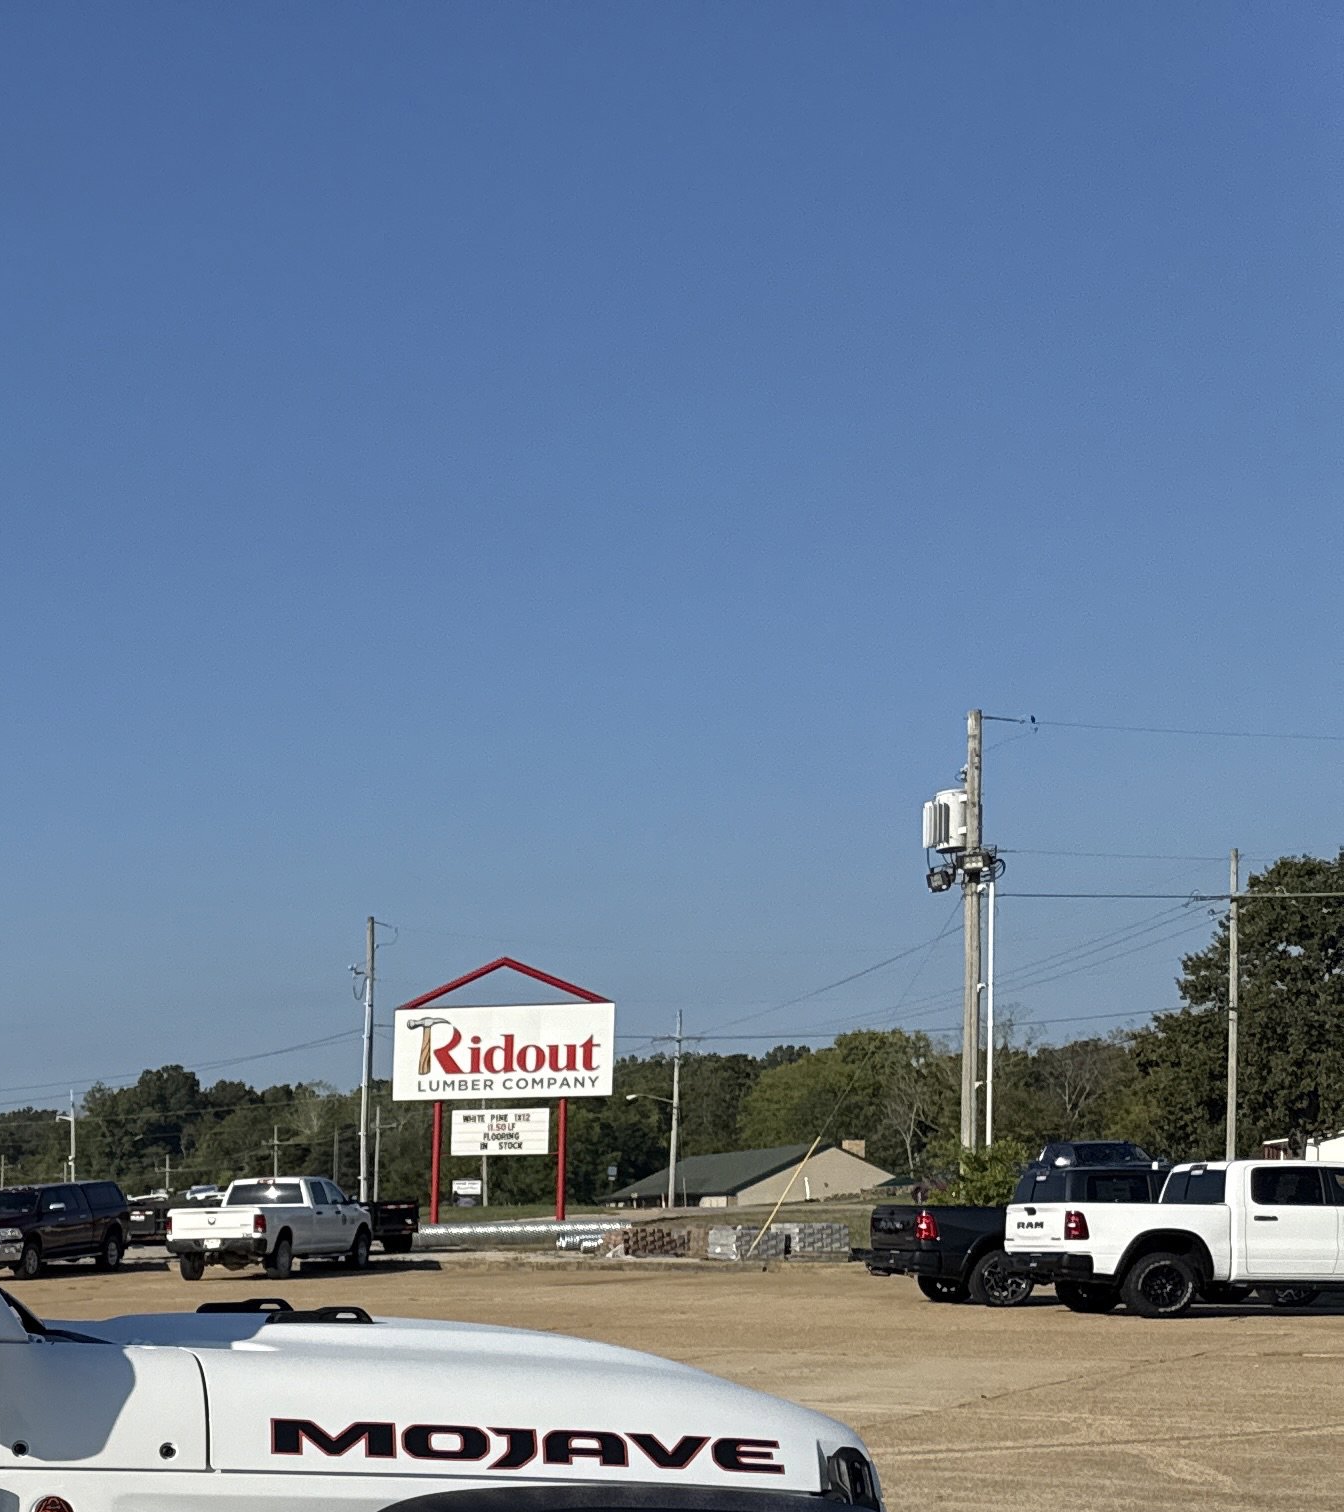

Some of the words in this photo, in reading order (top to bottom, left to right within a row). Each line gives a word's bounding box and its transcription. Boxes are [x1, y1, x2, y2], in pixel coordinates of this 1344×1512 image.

[407, 1017, 601, 1075] Ridout
[417, 1079, 494, 1093] LUMBER
[502, 1076, 600, 1090] COMPANY
[463, 1114, 485, 1123] WHITE
[491, 1114, 508, 1122] PINE
[483, 1132, 520, 1141] FLOORING
[480, 1142, 488, 1150] IN
[499, 1141, 523, 1150] STOCK
[1016, 1221, 1045, 1230] RAM
[270, 1418, 786, 1475] MOJAVE
